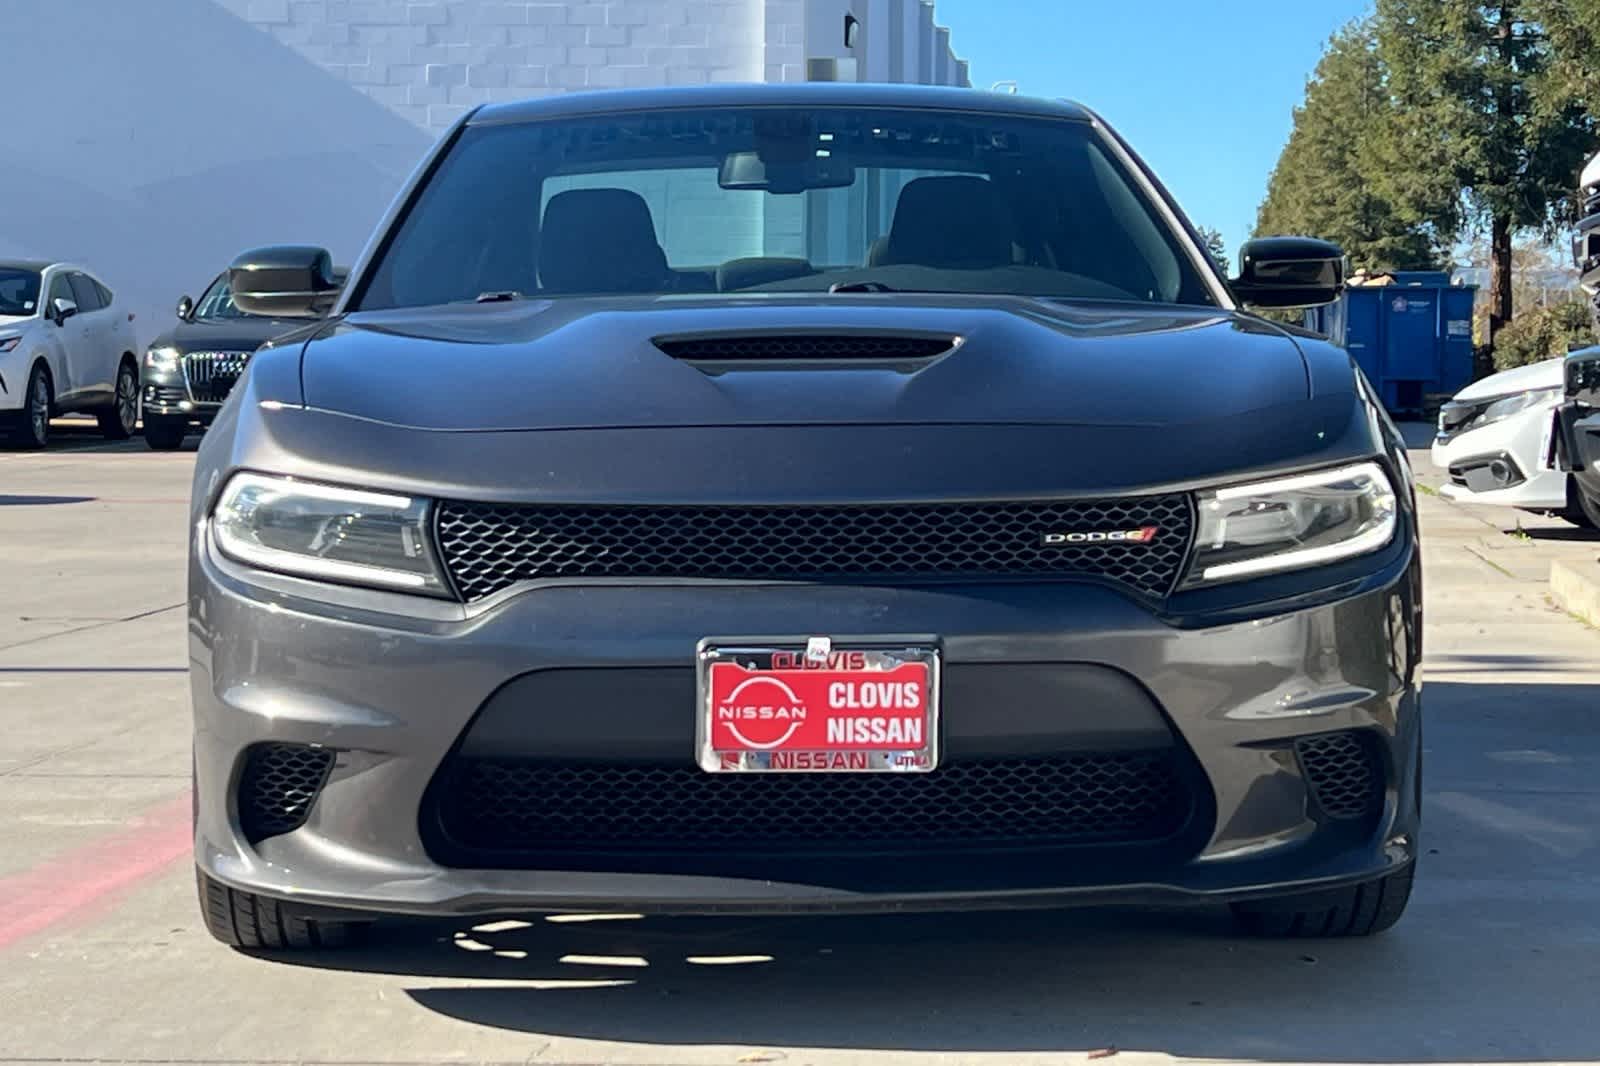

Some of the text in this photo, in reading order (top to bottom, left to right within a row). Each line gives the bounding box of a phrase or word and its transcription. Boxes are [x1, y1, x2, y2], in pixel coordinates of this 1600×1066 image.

[1045, 530, 1144, 543] DODGE
[829, 682, 920, 709] CLOVIS
[719, 706, 807, 719] NISSAN
[827, 717, 922, 743] NISSAN
[771, 751, 867, 769] NISSAN
